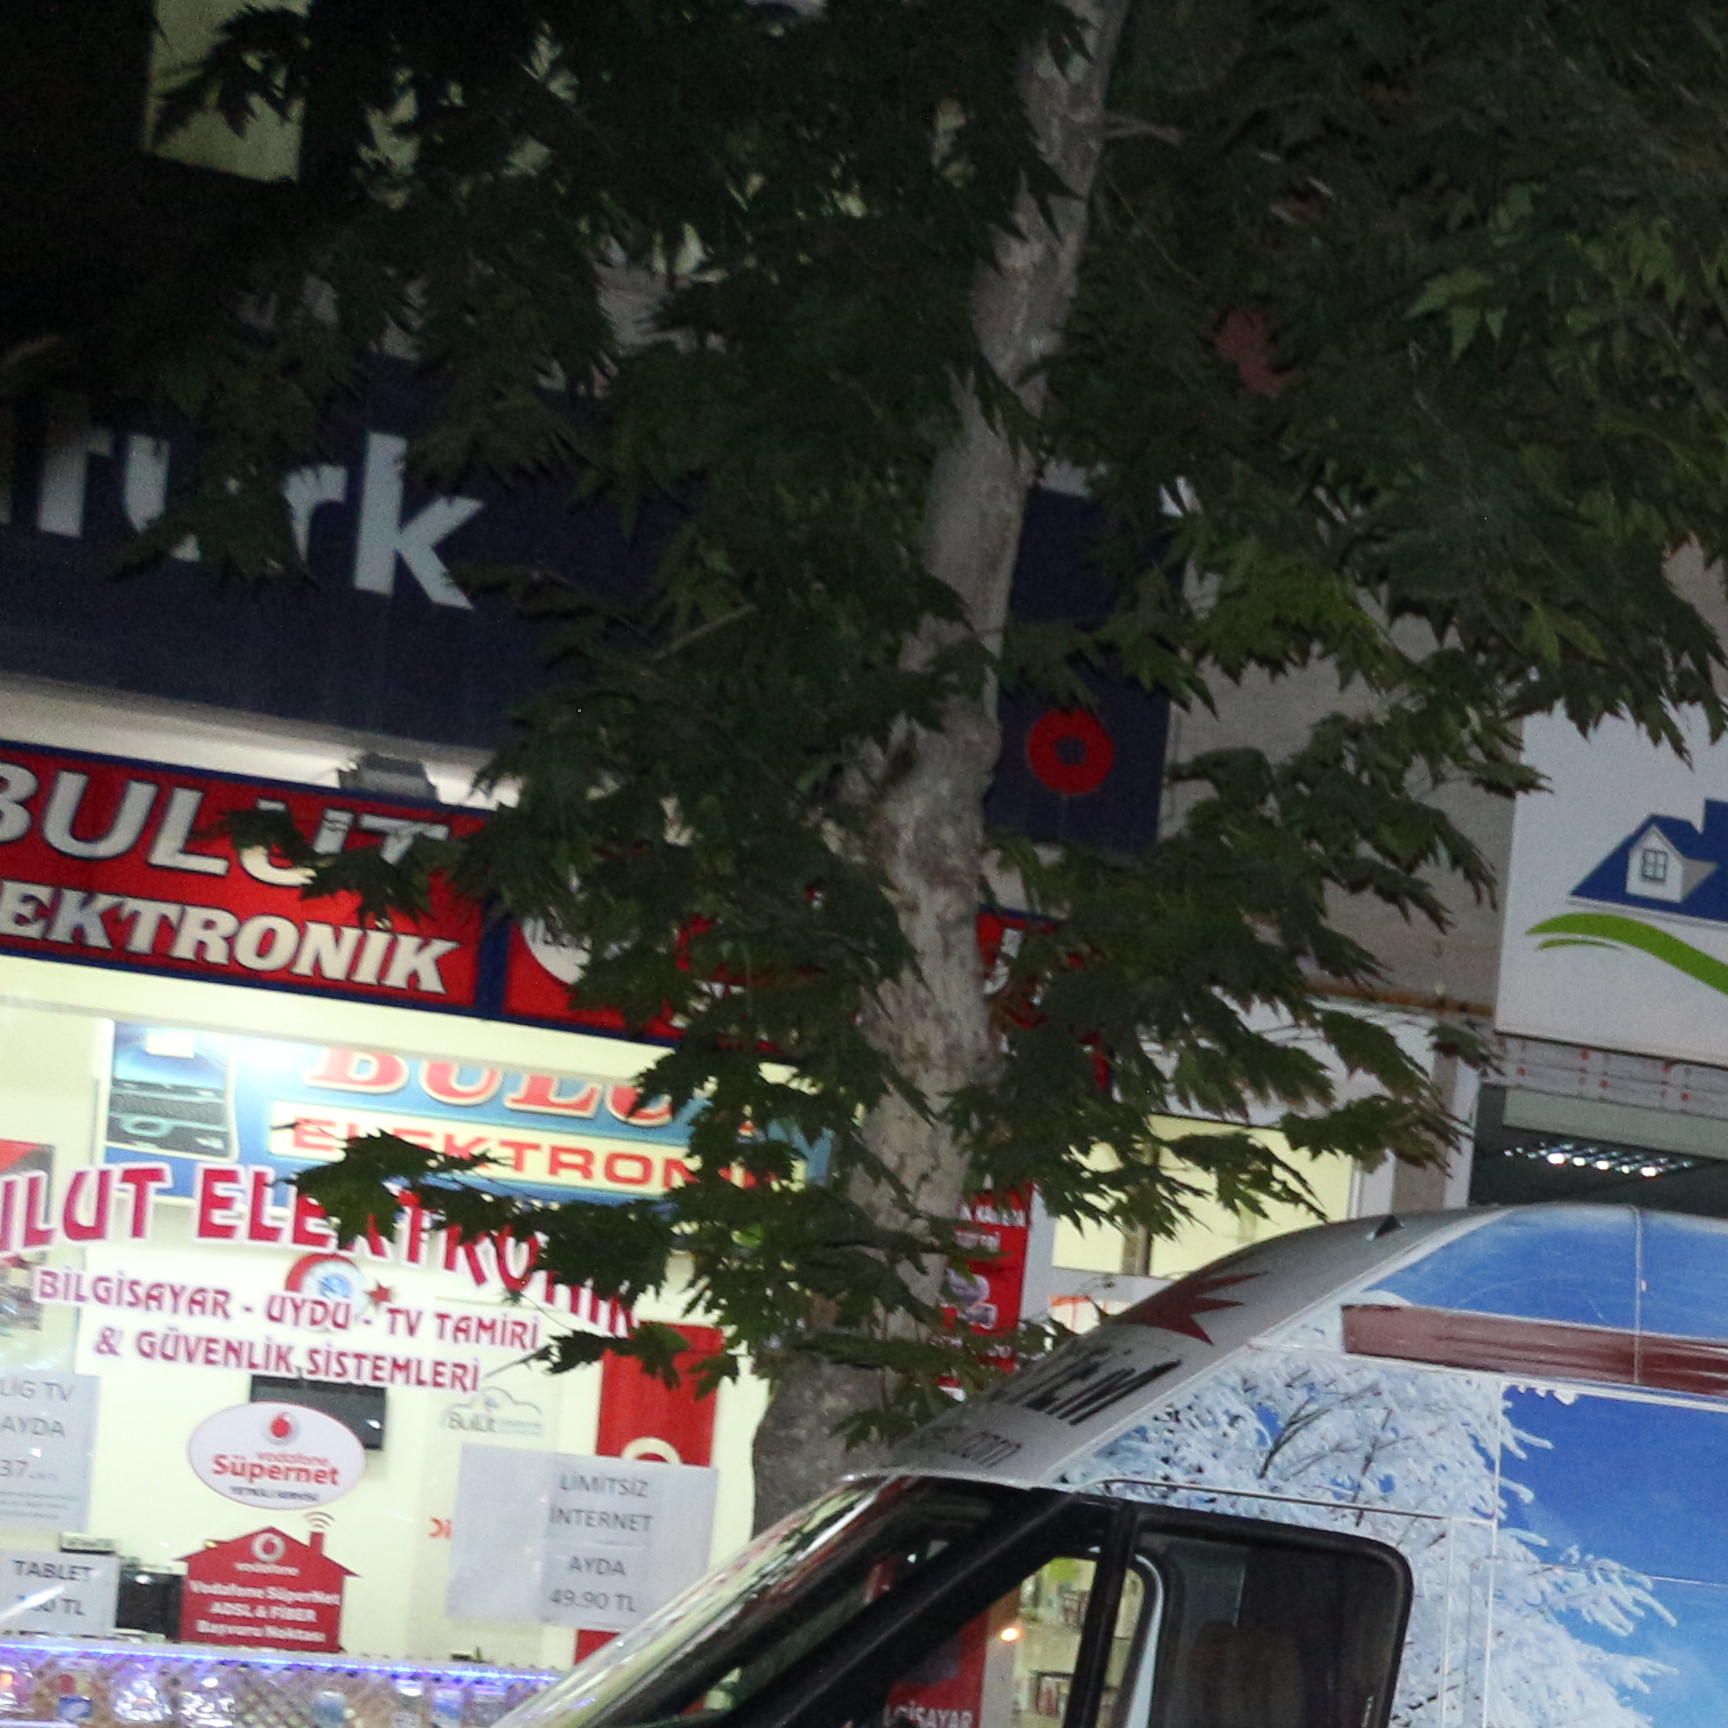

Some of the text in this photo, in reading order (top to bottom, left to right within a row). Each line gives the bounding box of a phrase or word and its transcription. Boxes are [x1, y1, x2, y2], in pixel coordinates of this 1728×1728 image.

[36, 1266, 232, 1320] BİLGİSAYAR
[266, 1295, 352, 1330] UYDU
[386, 1307, 426, 1336] TV
[437, 1310, 540, 1351] TAMİRİ
[95, 1324, 480, 1394] & GÜVENLİK SİSTEMLERİ
[568, 1555, 628, 1578] AYDA
[612, 1592, 637, 1613] TL
